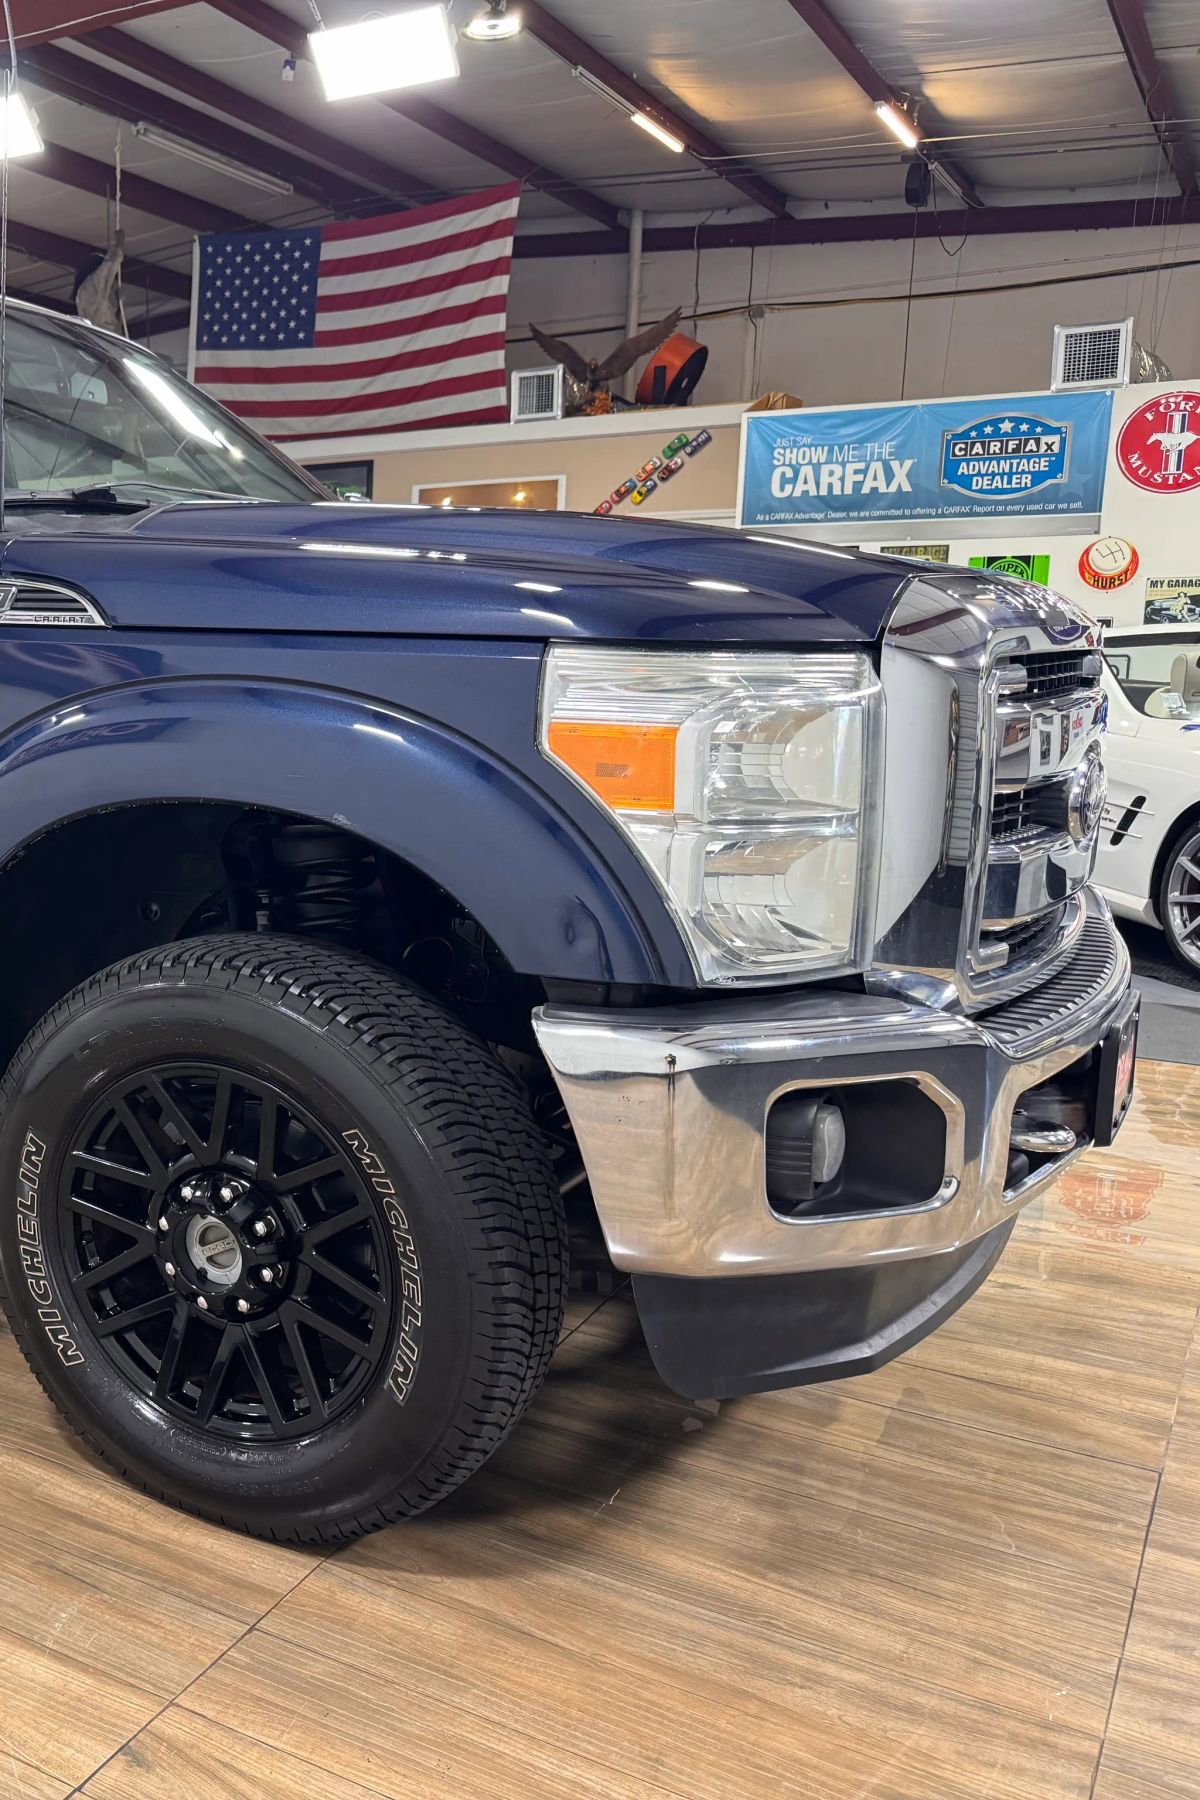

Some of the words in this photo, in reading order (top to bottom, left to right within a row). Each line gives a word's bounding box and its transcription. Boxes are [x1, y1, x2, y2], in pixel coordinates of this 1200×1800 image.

[1143, 400, 1200, 421] FOR
[773, 437, 793, 448] JUST
[796, 436, 813, 446] SAY
[954, 439, 1057, 456] CARFAX
[773, 446, 828, 466] SHOW
[832, 444, 860, 462] ME
[864, 442, 896, 461] THE
[957, 457, 1050, 475] ADVANTAGE
[770, 459, 914, 498] CARFAX
[971, 474, 1032, 490] DEALER
[770, 513, 794, 521] CARFAX
[794, 512, 824, 521] Advantage
[828, 511, 848, 519] Dealer,
[870, 509, 903, 517] committed
[912, 507, 936, 516] offering
[943, 506, 969, 514] CARFAX
[973, 505, 995, 514] Report
[1006, 505, 1024, 513] every
[1026, 503, 1043, 511] used
[1069, 501, 1083, 509] sell.
[1093, 566, 1130, 589] HURST
[1149, 580, 1165, 588] MY
[17, 1126, 85, 1366] MICHELIN
[342, 1129, 422, 1406] MICHELIN
